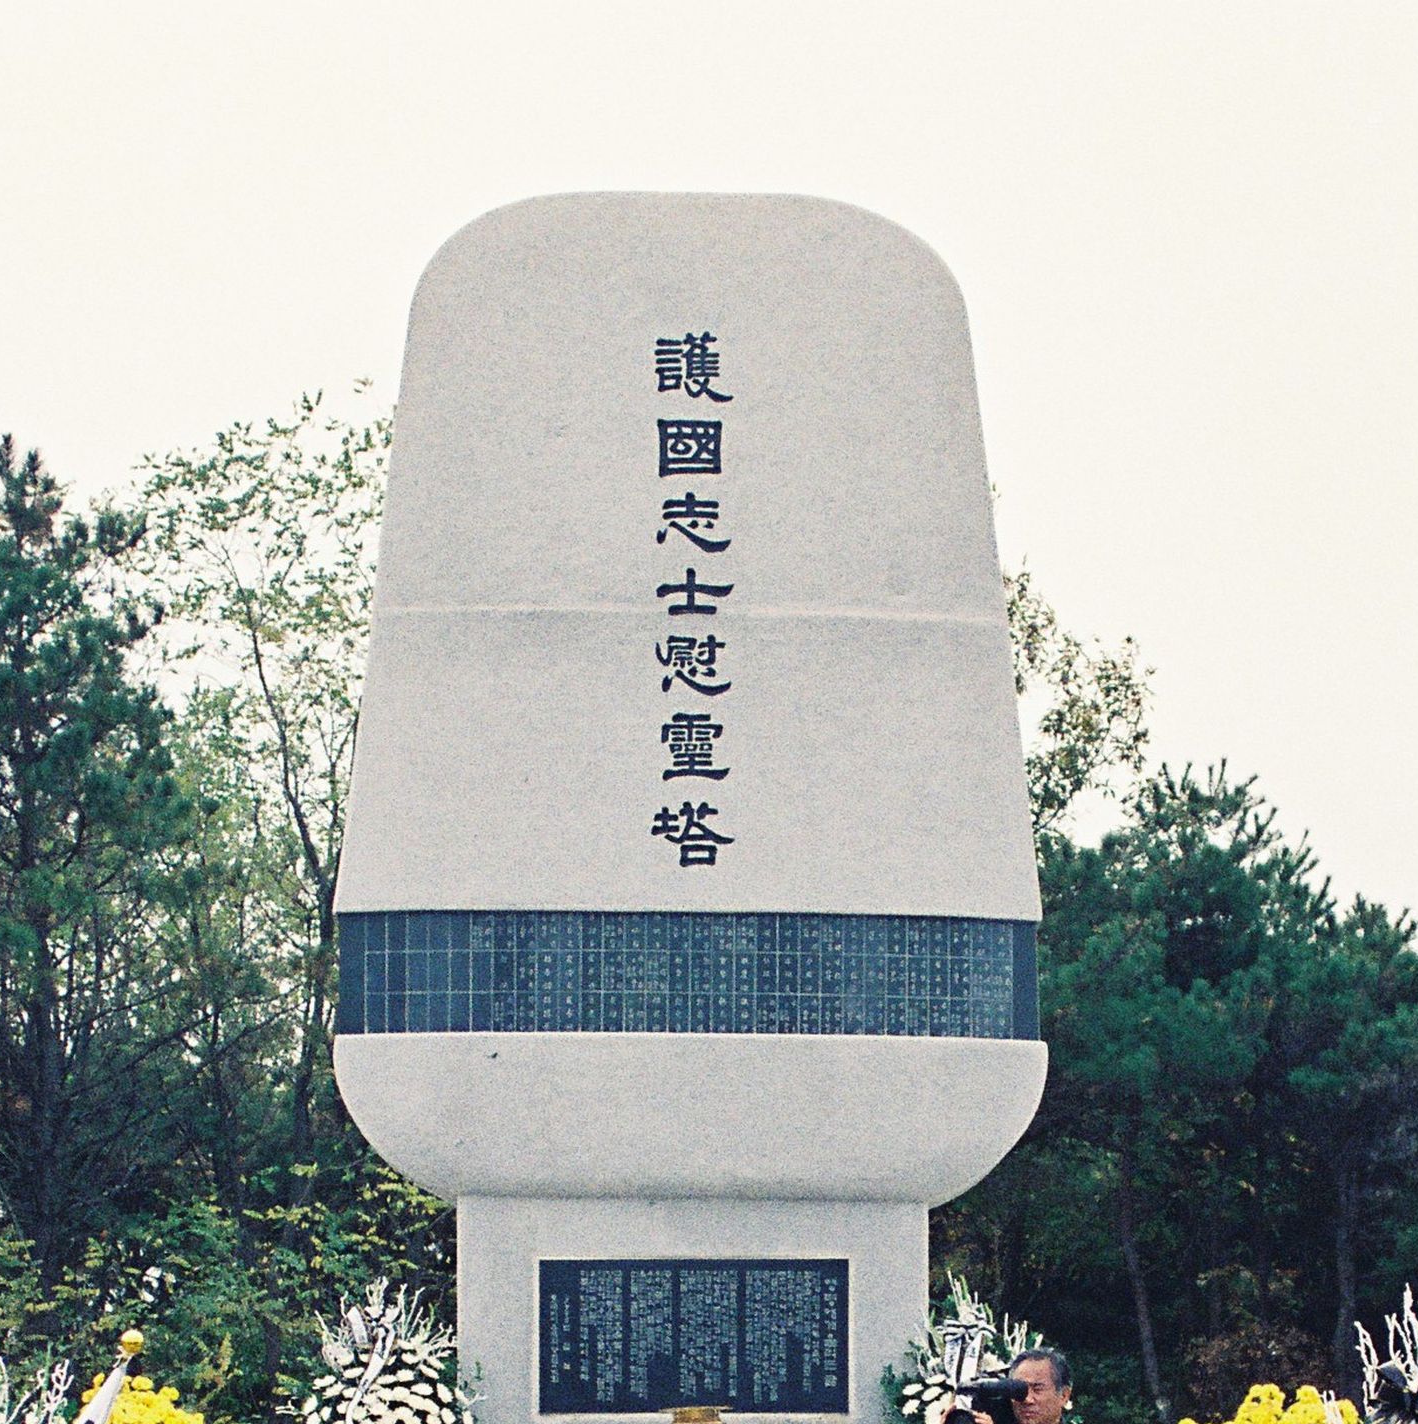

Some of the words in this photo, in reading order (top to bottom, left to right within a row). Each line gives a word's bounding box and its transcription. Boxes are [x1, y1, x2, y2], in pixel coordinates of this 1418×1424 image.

[651, 332, 736, 868] 護國志士慰靈塔
